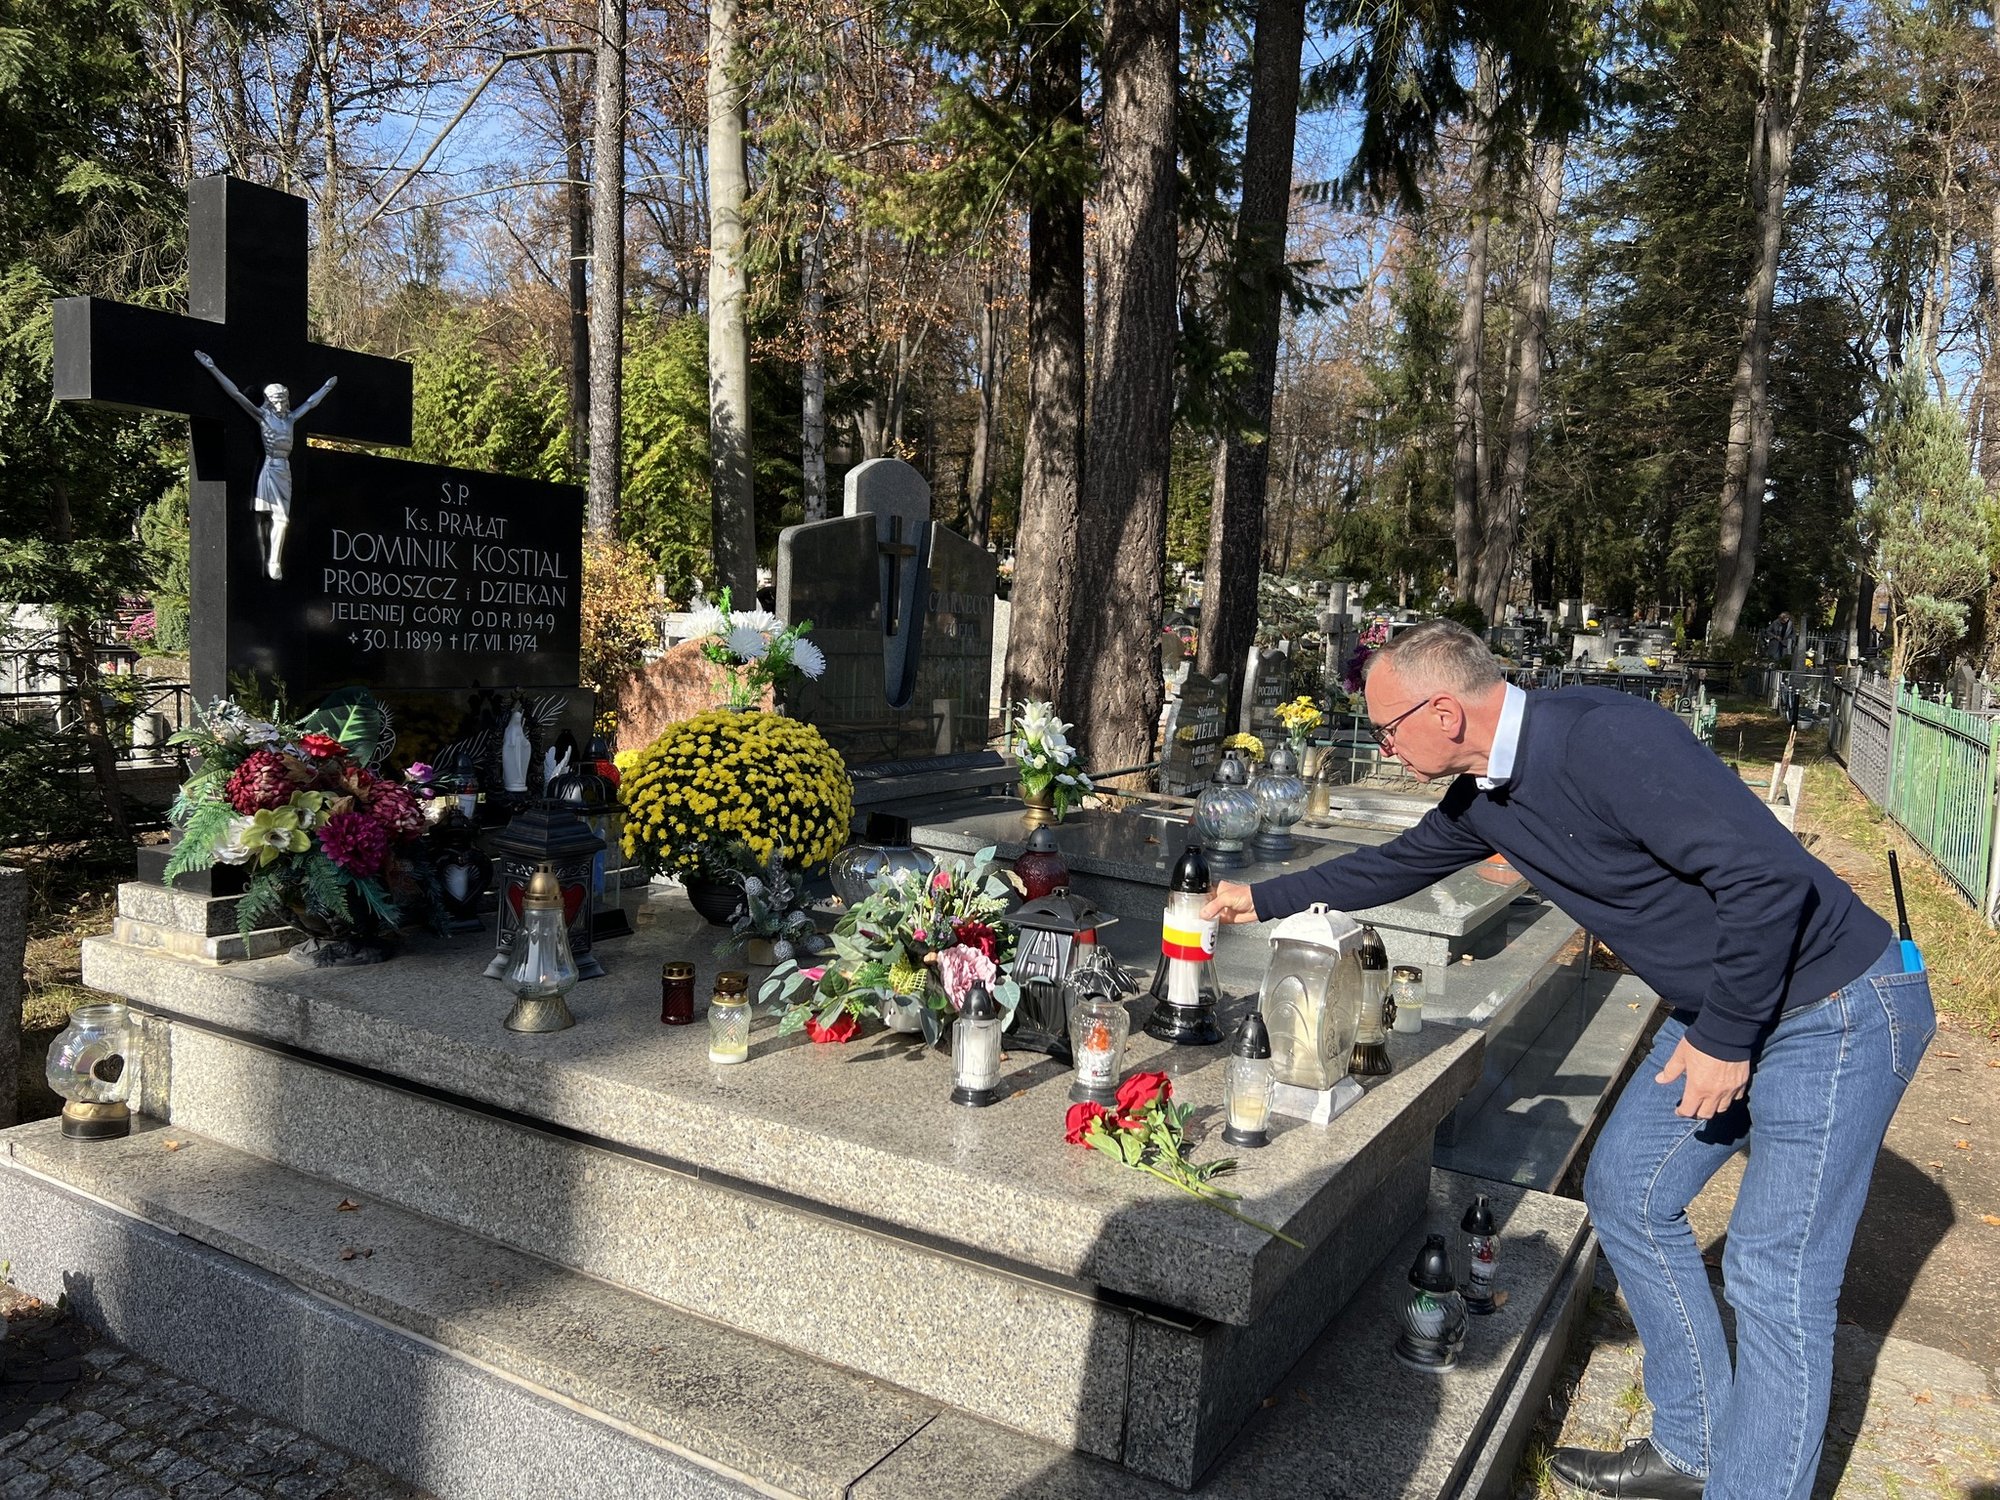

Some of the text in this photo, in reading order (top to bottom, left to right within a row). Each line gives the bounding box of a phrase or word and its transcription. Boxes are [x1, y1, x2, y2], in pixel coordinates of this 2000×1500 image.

[404, 506, 508, 540] Ks. PRAŁAT
[331, 528, 569, 579] DOMINIK KOSTIAL
[323, 568, 567, 608] PROBOSZCZ i DZIEKAN
[329, 602, 405, 626] JELENIEJ
[412, 605, 462, 627] GÓRY
[508, 633, 539, 655] 1974
[1189, 721, 1219, 742] PIELA
